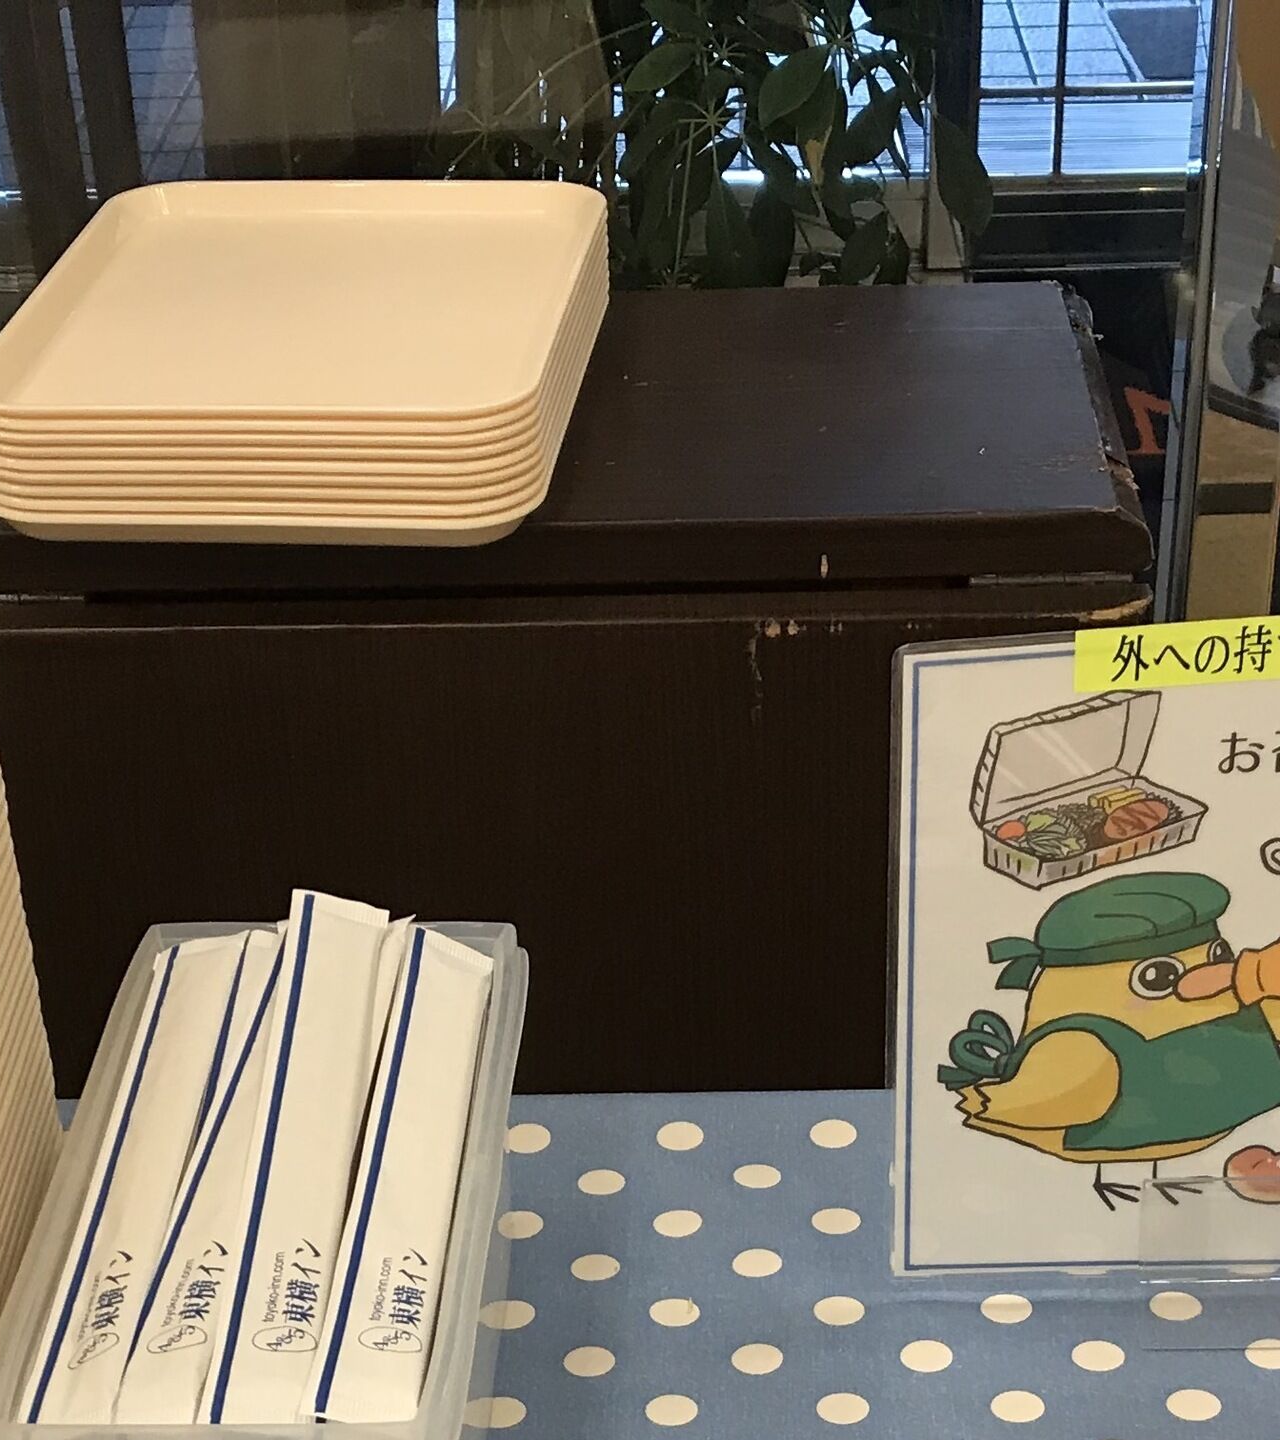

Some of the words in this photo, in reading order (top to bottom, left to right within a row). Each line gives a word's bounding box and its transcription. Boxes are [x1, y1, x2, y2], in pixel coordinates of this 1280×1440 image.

[183, 1239, 230, 1322] 東横イン
[282, 1238, 322, 1327] 東横イン
[390, 1248, 429, 1328] 東横イン
